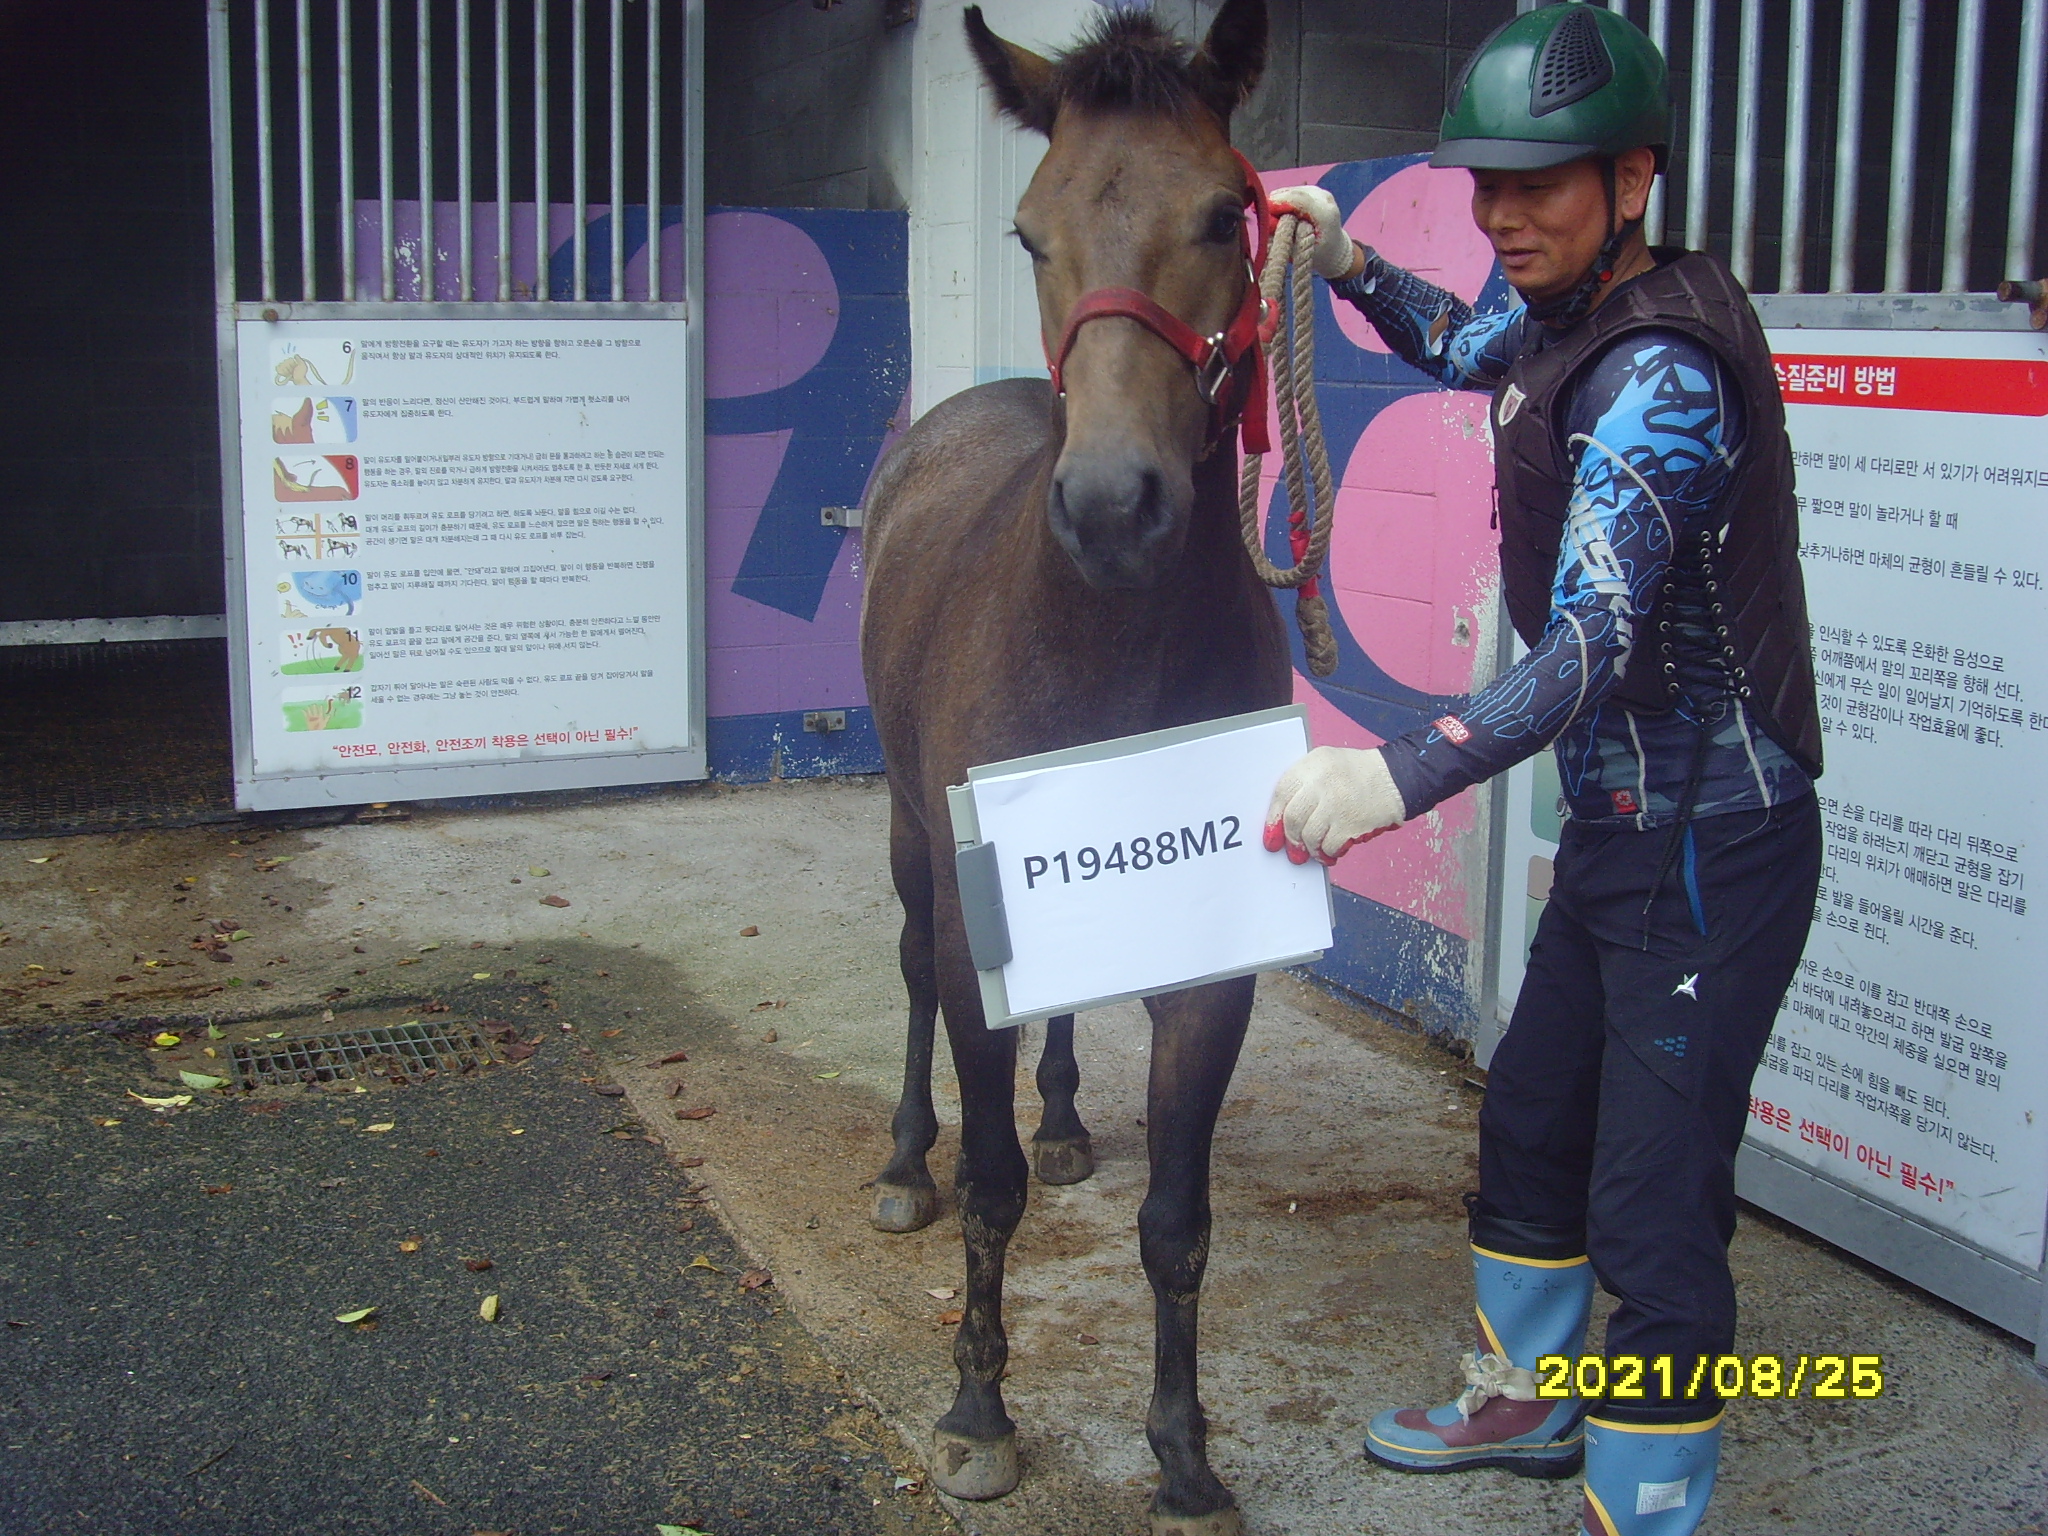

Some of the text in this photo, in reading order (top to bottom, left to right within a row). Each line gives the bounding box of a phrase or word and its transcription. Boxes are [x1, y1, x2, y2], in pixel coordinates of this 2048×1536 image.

[342, 341, 352, 354] 6
[1854, 365, 1896, 396] 방법
[344, 400, 353, 412] 7
[345, 458, 354, 470] 8
[1828, 453, 1850, 470] 말이
[1854, 455, 1866, 472] 세
[1870, 456, 1918, 476] 다리로만
[1922, 461, 1935, 478] 서
[1940, 462, 1979, 482] 있기가
[1811, 497, 1844, 516] 짧으면
[1849, 501, 1871, 519] 말이
[1875, 504, 1924, 525] 놀라거나
[1928, 509, 1942, 527] 할
[1945, 512, 1958, 529] 때
[341, 573, 357, 585] 10
[1869, 551, 1904, 570] 마체의
[1908, 556, 1945, 576] 균형이
[1949, 560, 1989, 582] 흔들릴
[1993, 567, 2007, 584] 수
[2012, 569, 2043, 589] 있다.
[347, 630, 359, 642] 11
[1819, 625, 1853, 645] 인식할
[1855, 631, 1868, 647] 수
[1872, 634, 1907, 655] 있도록
[1911, 641, 1949, 663] 온화한
[1952, 648, 2004, 671] 음성으로
[346, 686, 362, 699] 12
[1821, 648, 1877, 673] 어깨쯤에서
[1881, 659, 1905, 678] 말의
[1908, 665, 1959, 689] 꼬리쪽을
[1963, 674, 1989, 695] 향해
[1993, 680, 2023, 702] 선다.
[1820, 693, 2003, 747] 것이 균형감이나 작업효율에 좋다.
[1849, 676, 1873, 695] 무슨
[1877, 682, 1900, 701] 일이
[1905, 687, 1954, 712] 일어날지
[1958, 699, 2024, 726] 기억하도록
[387, 740, 430, 755] 안전화,
[435, 737, 487, 752] 안전조끼
[491, 733, 529, 748] 착용은
[534, 731, 571, 746] 선택이
[575, 730, 600, 743] 아닌
[1821, 716, 1877, 743] 알 수 있다.
[1022, 815, 1243, 889] P19488M2
[1825, 820, 2024, 889] 작업을 하려는지 깨닫고 균형을 잡기
[1842, 802, 1865, 822] 손을
[1869, 810, 1904, 832] 다리를
[1908, 820, 1933, 840] 따라
[1937, 828, 1961, 848] 다리
[1966, 835, 2018, 862] 뒤쪽으로
[1827, 844, 2027, 915] 다리의 위치가 애매하면 말은 다리를
[1825, 910, 1859, 933] 손으로
[1863, 922, 1889, 944] 쥔다.
[1832, 889, 1855, 910] 발을
[1858, 897, 1904, 926] 들어올릴
[1908, 914, 1945, 939] 시간을
[1949, 925, 1978, 949] 준다.
[1802, 981, 1834, 1005] 바닥에
[1839, 994, 1907, 1030] 내려놓으려고
[1911, 1020, 1935, 1042] 하면
[1940, 1030, 1965, 1053] 발굽
[1969, 1041, 2008, 1069] 앞쪽을
[1821, 966, 1855, 989] 손으로
[1859, 979, 1882, 1000] 이를
[1886, 988, 1909, 1008] 잡고
[1914, 997, 1950, 1024] 반대쪽
[1954, 1013, 1992, 1039] 손으로
[1792, 999, 1825, 1023] 마체에
[1828, 1013, 1850, 1032] 대고
[1854, 1022, 1889, 1048] 약간의
[1892, 1037, 1929, 1063] 체중을
[1933, 1052, 1970, 1079] 실으면
[1975, 1067, 2000, 1091] 말의
[1790, 1041, 1812, 1061] 잡고
[1815, 1051, 1837, 1072] 있는
[1840, 1062, 1863, 1083] 손에
[1868, 1071, 1890, 1094] 힘을
[1922, 1094, 1950, 1119] 된다.
[1792, 1064, 1814, 1084] 파되
[1818, 1074, 1851, 1100] 다리를
[1854, 1089, 1912, 1126] 작업자쪽을
[1916, 1114, 1952, 1143] 당기지
[1957, 1132, 1997, 1162] 않는다.
[1798, 1119, 1850, 1157] 선택이
[1856, 1144, 1893, 1178] 아닌
